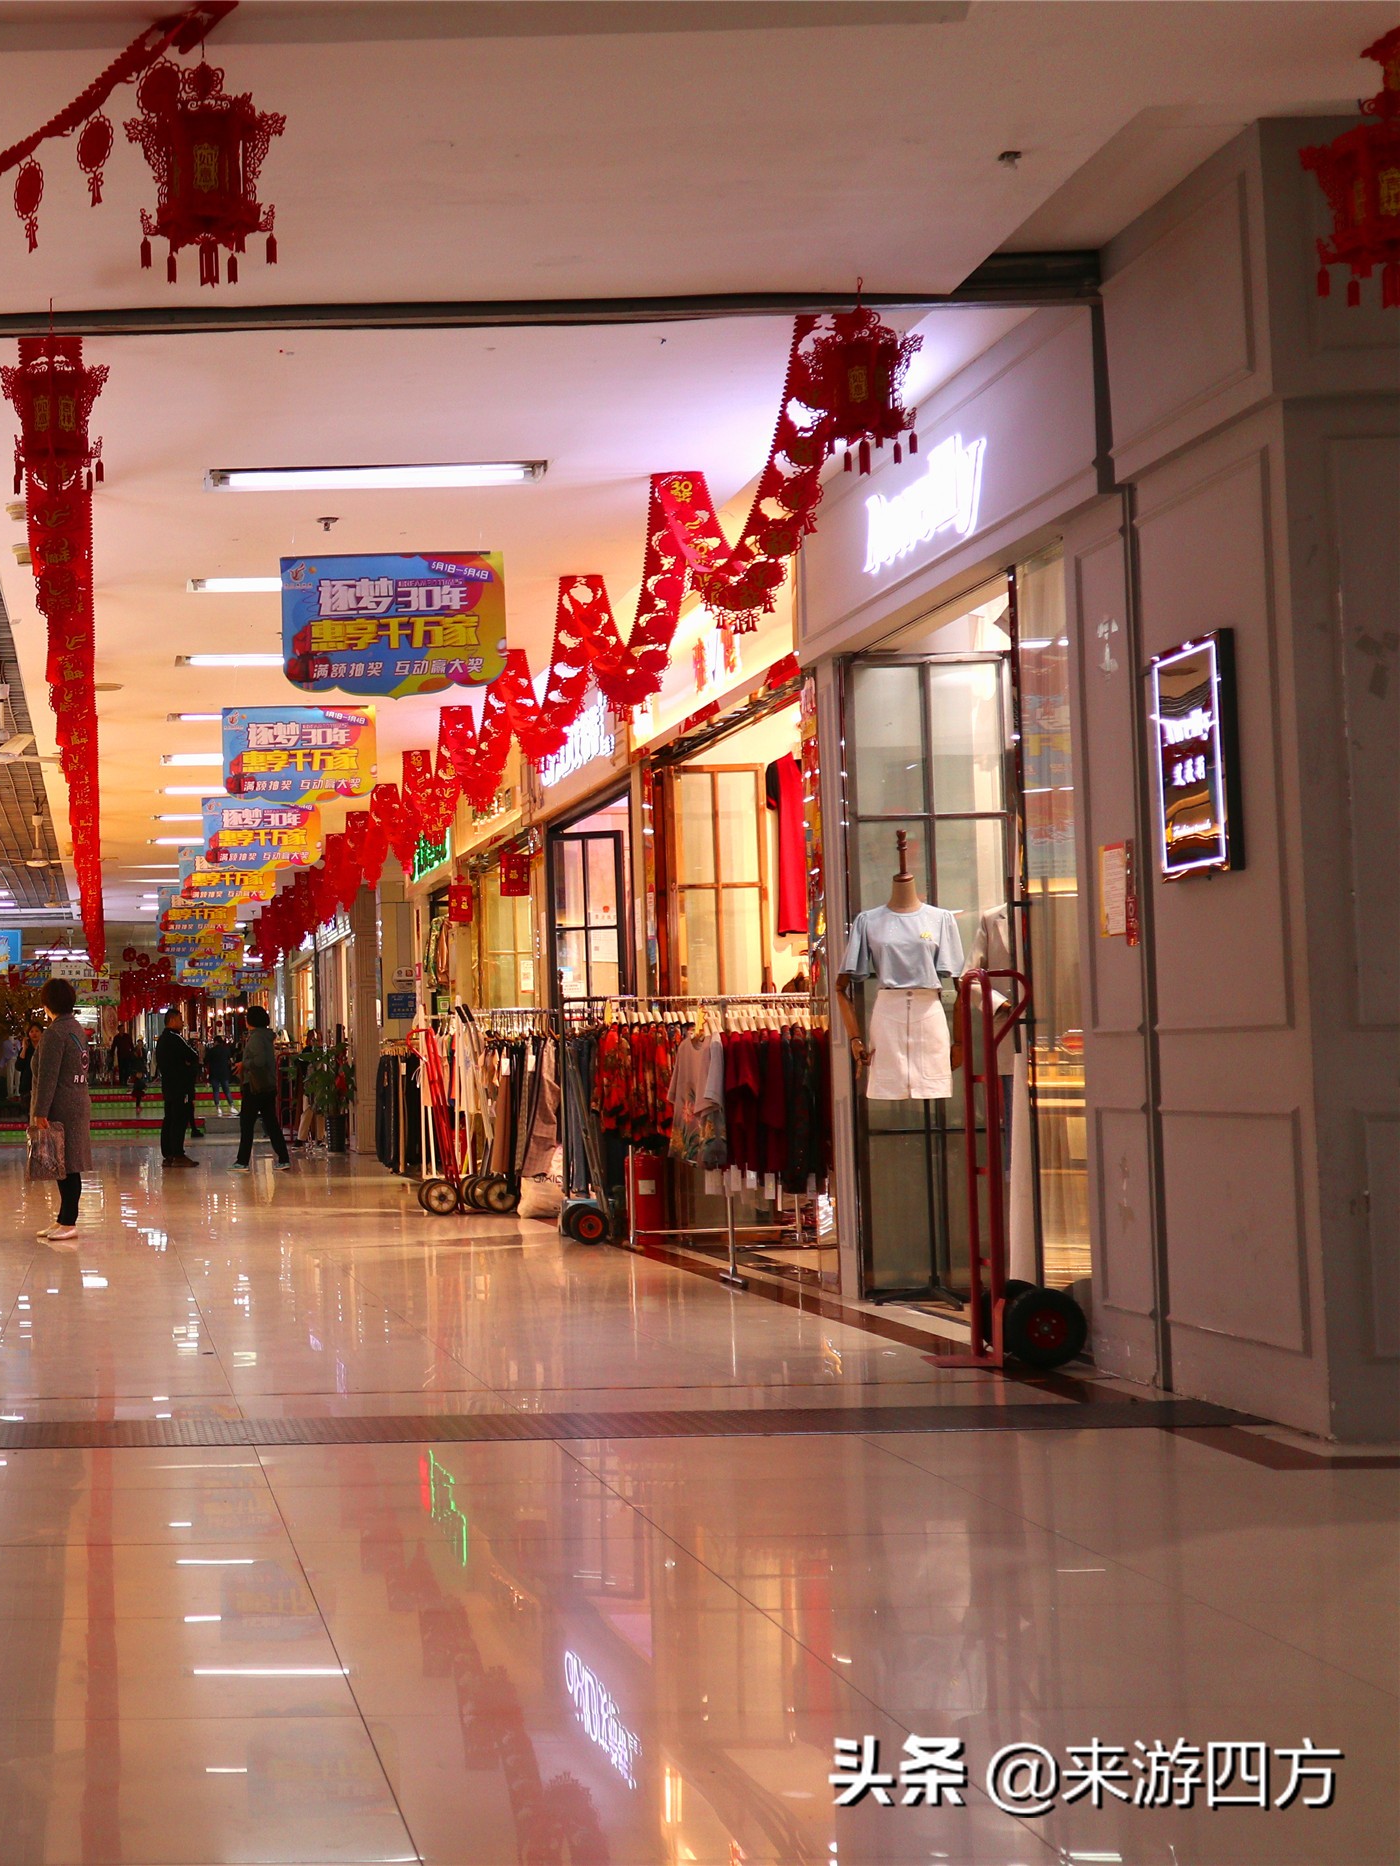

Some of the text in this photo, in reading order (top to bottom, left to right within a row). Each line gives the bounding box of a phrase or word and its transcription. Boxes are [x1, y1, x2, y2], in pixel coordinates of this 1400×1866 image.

[318, 577, 468, 616] 逐梦30年
[310, 614, 480, 651] 惠享千万家
[313, 657, 484, 679] 满额抽奖 互动赢大奖
[248, 722, 351, 748] 逐梦30年
[242, 748, 359, 773] 惠享千万家
[244, 778, 361, 791] 满额抽奖 互动赢大奖
[222, 809, 301, 828] 逐梦30年
[218, 829, 307, 847] 惠享千万家
[220, 853, 257, 861] 满额抽奖
[191, 871, 264, 887] 惠享千万家
